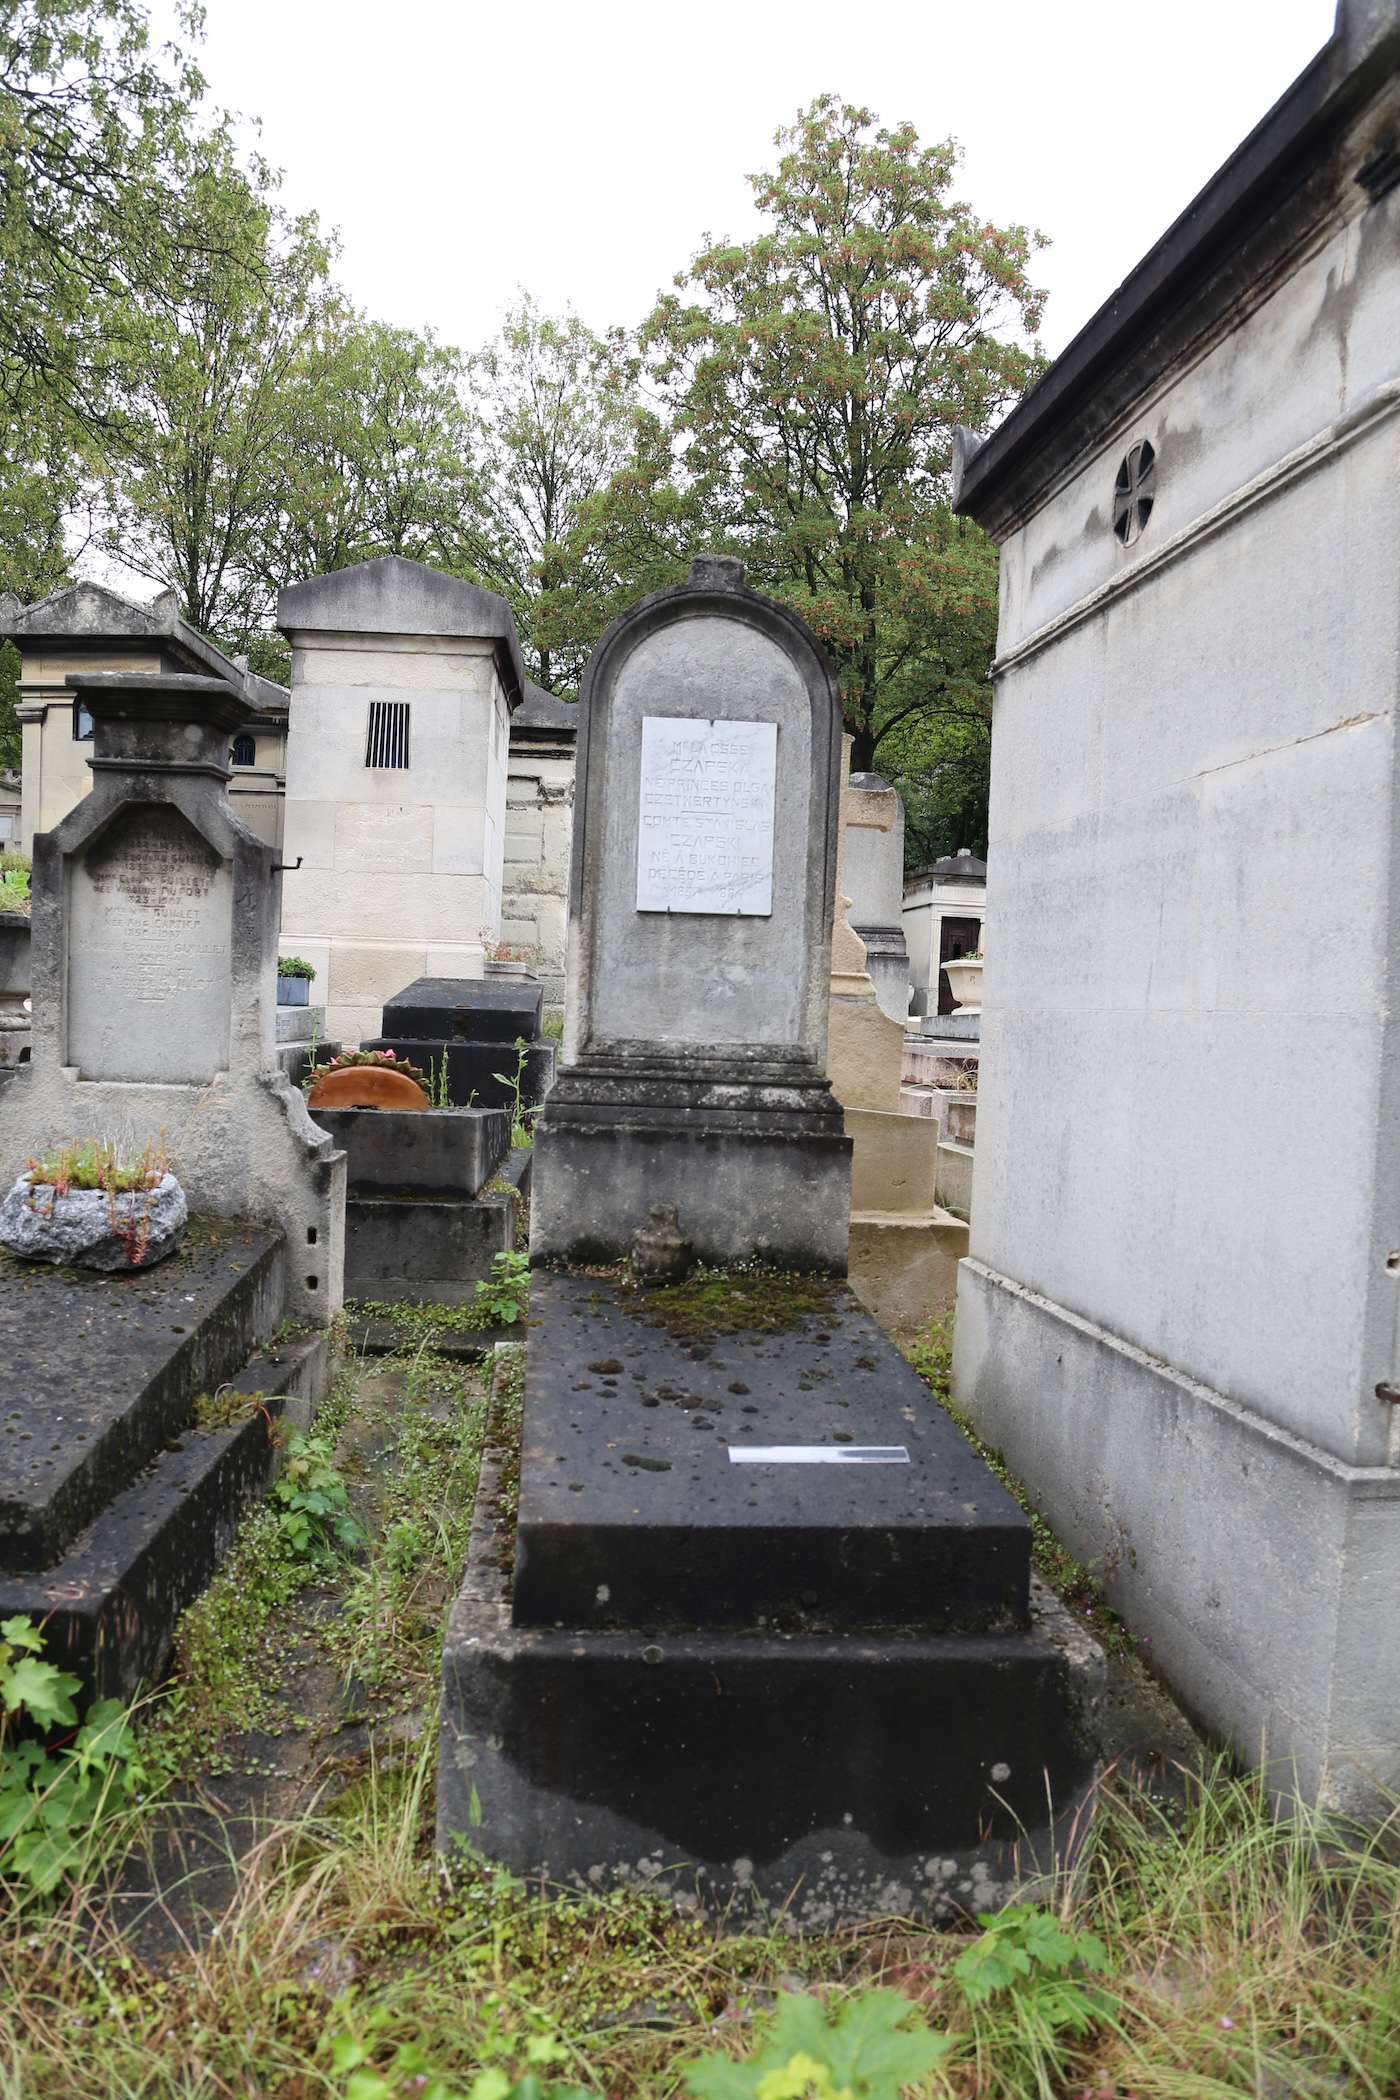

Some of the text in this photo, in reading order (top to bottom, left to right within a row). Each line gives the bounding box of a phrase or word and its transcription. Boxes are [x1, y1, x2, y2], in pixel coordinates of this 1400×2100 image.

[670, 758, 747, 775] CZAPSKA
[734, 781, 770, 795] OLGA
[643, 815, 771, 832] COMTE STANISLAS
[670, 833, 741, 850] CZAPSKI
[651, 848, 670, 863] NÉ
[689, 853, 760, 868] BUKOWIEC
[648, 866, 706, 881] DÉCÉDÉ
